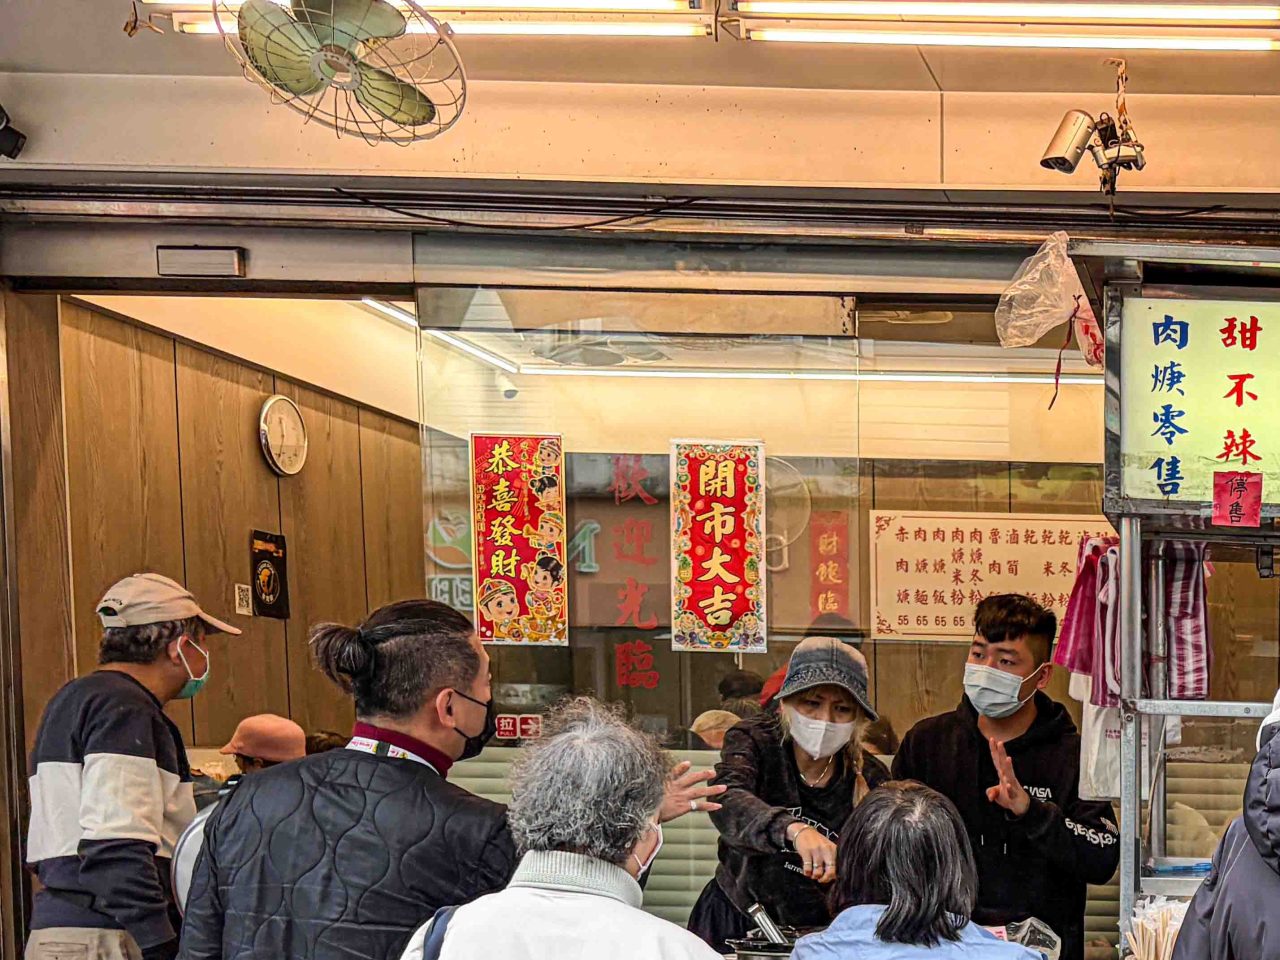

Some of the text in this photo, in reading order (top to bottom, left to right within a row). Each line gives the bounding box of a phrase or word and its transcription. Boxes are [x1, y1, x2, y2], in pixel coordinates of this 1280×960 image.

[1153, 316, 1188, 495] 肉焿零售
[1218, 316, 1261, 464] 甜不辣
[485, 440, 524, 578] 恭喜發財
[696, 459, 741, 627] 開市大吉
[1225, 476, 1248, 524] 停售
[605, 455, 661, 689] 歡迎光臨
[895, 527, 910, 626] 赤肉焿 55
[916, 615, 929, 627] 65
[934, 615, 947, 627] 65
[952, 616, 966, 627] 65
[500, 718, 514, 731] 拉
